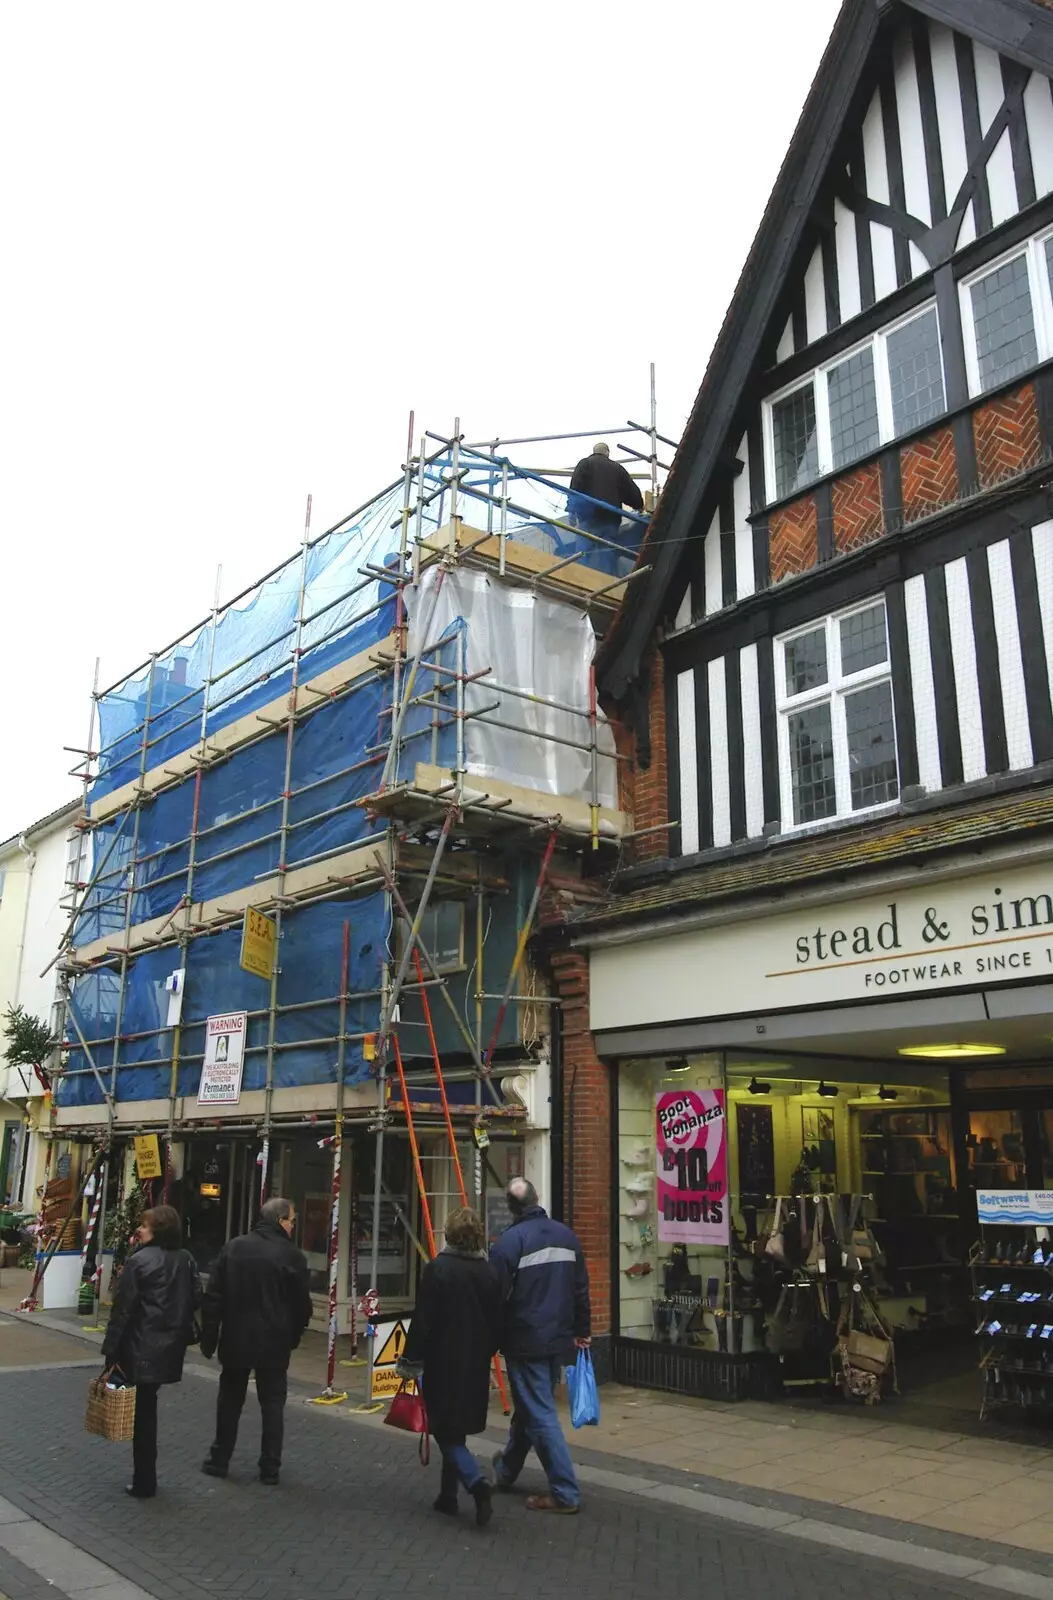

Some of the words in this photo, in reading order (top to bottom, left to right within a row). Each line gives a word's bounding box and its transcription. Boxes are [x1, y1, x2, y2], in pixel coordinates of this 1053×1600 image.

[796, 903, 902, 963] stead
[922, 907, 951, 943] &
[865, 961, 962, 988] FOOTWEAR
[976, 951, 1031, 973] SINCE
[210, 1017, 242, 1030] WARNING
[204, 1083, 235, 1093] Permanex
[659, 1096, 690, 1123] Boot
[663, 1104, 723, 1139] bonanza
[663, 1148, 707, 1191] £10
[664, 1194, 723, 1223] boots
[668, 1291, 713, 1309] simpson
[373, 1383, 398, 1393] Building
